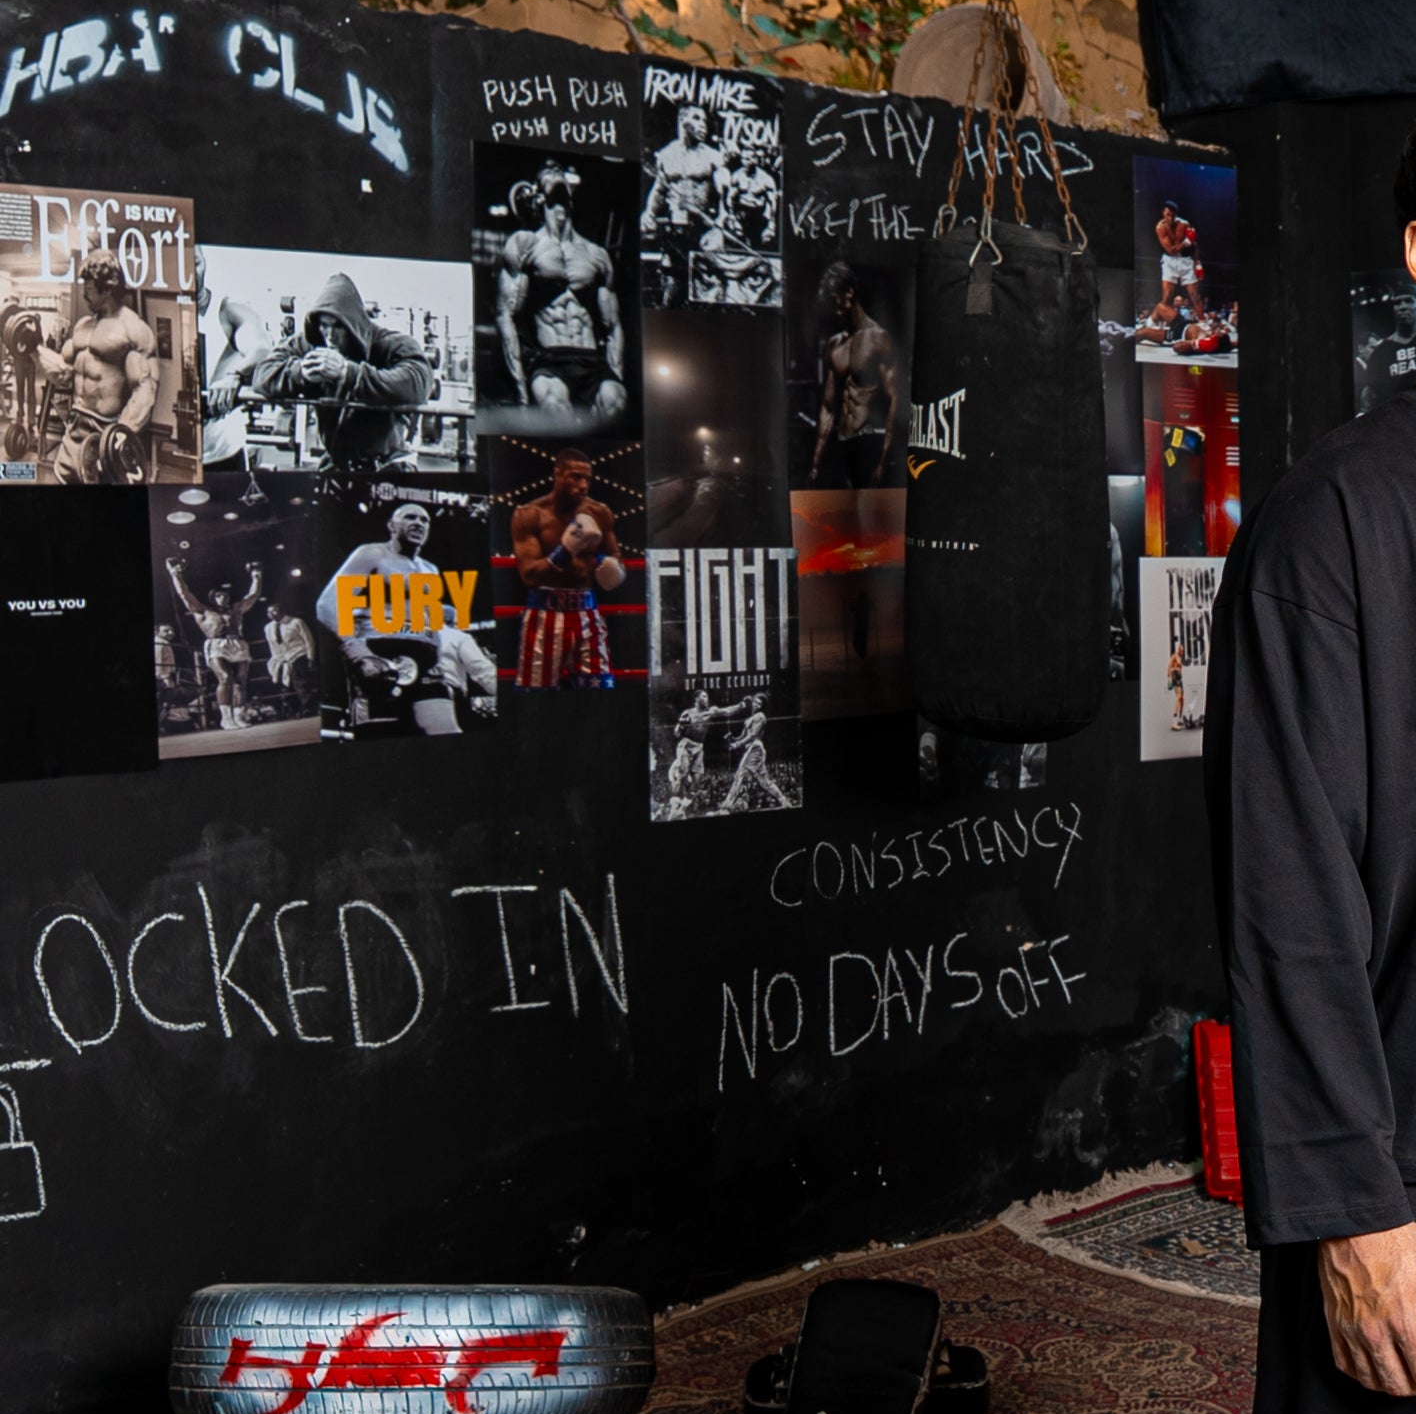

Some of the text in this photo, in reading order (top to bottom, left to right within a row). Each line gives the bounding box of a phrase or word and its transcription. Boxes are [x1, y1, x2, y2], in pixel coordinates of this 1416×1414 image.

[483, 75, 627, 112] PUSH PUSH
[643, 65, 758, 112] IRON MIKE
[491, 117, 617, 146] PUSH PUSH
[718, 111, 780, 148] TYSON
[806, 103, 1094, 181] STAY HARD
[125, 204, 177, 223] IS KEY
[789, 195, 859, 239] KEEP
[862, 193, 925, 240] THE
[1396, 347, 1416, 361] BE
[437, 490, 469, 507] PPV
[8, 598, 86, 611] YOU VS YOU
[336, 570, 479, 637] FURY
[645, 548, 798, 676] FIGHT
[771, 803, 1082, 907] CONSISTENCY
[0, 873, 628, 1069] OCKED IN
[719, 933, 1087, 1092] NO DAYS OFF
